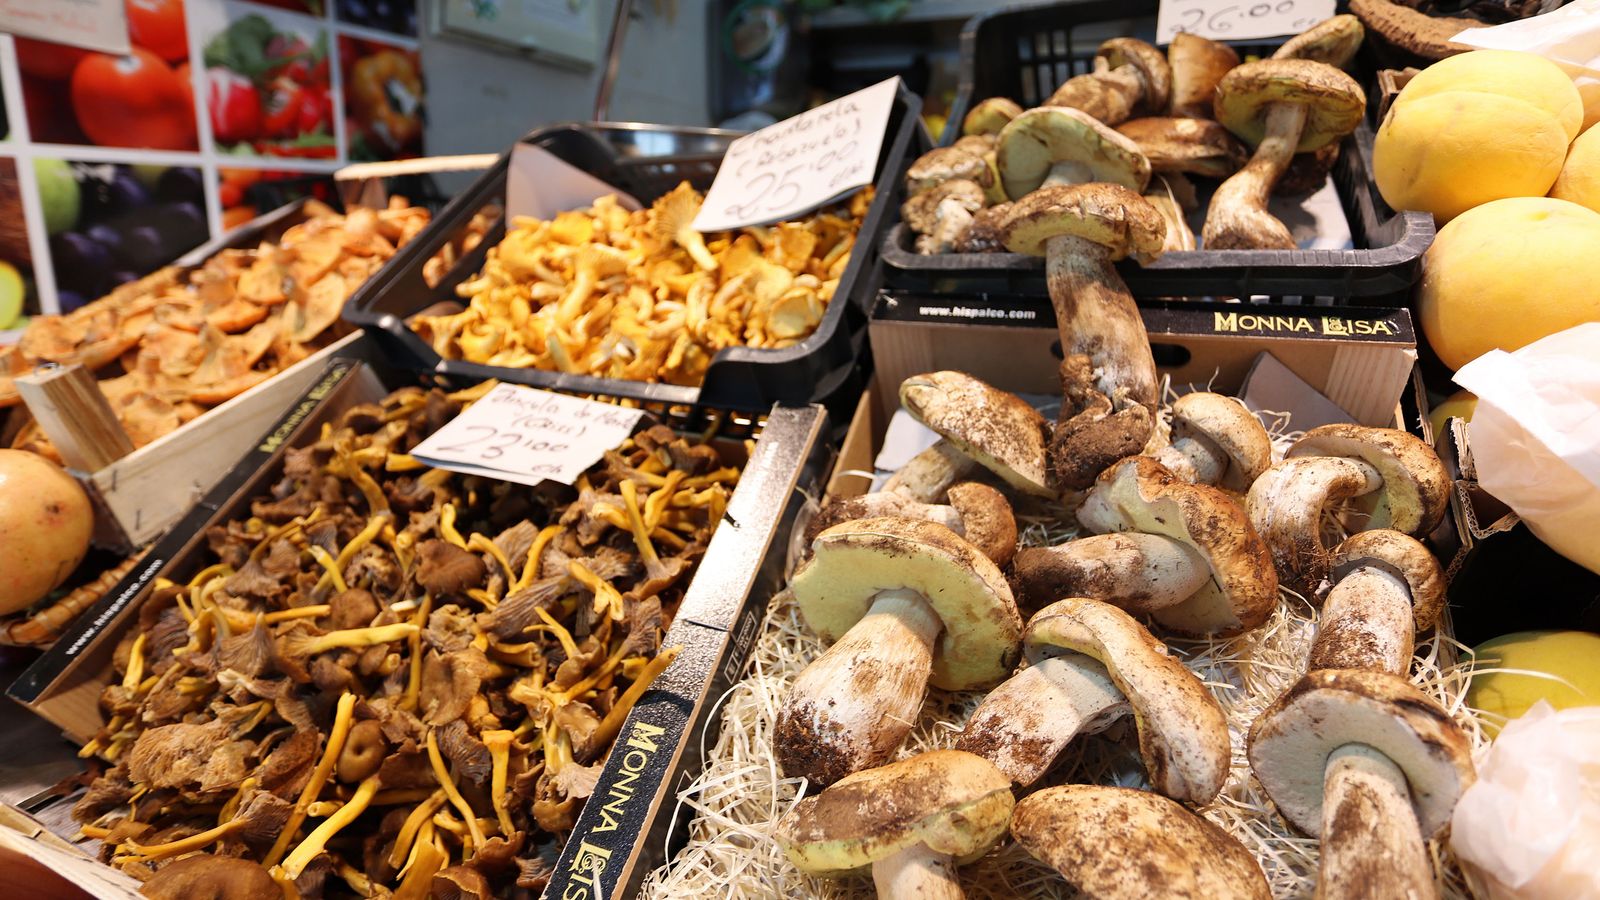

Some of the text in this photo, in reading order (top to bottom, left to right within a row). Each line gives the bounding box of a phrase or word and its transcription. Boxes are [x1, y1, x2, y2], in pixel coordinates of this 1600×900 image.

[919, 306, 1036, 319] www.hispalco.com
[1214, 312, 1393, 336] MONNA LISA
[65, 559, 163, 654] www.hispalco.com
[562, 720, 666, 900] MONNA LIS
